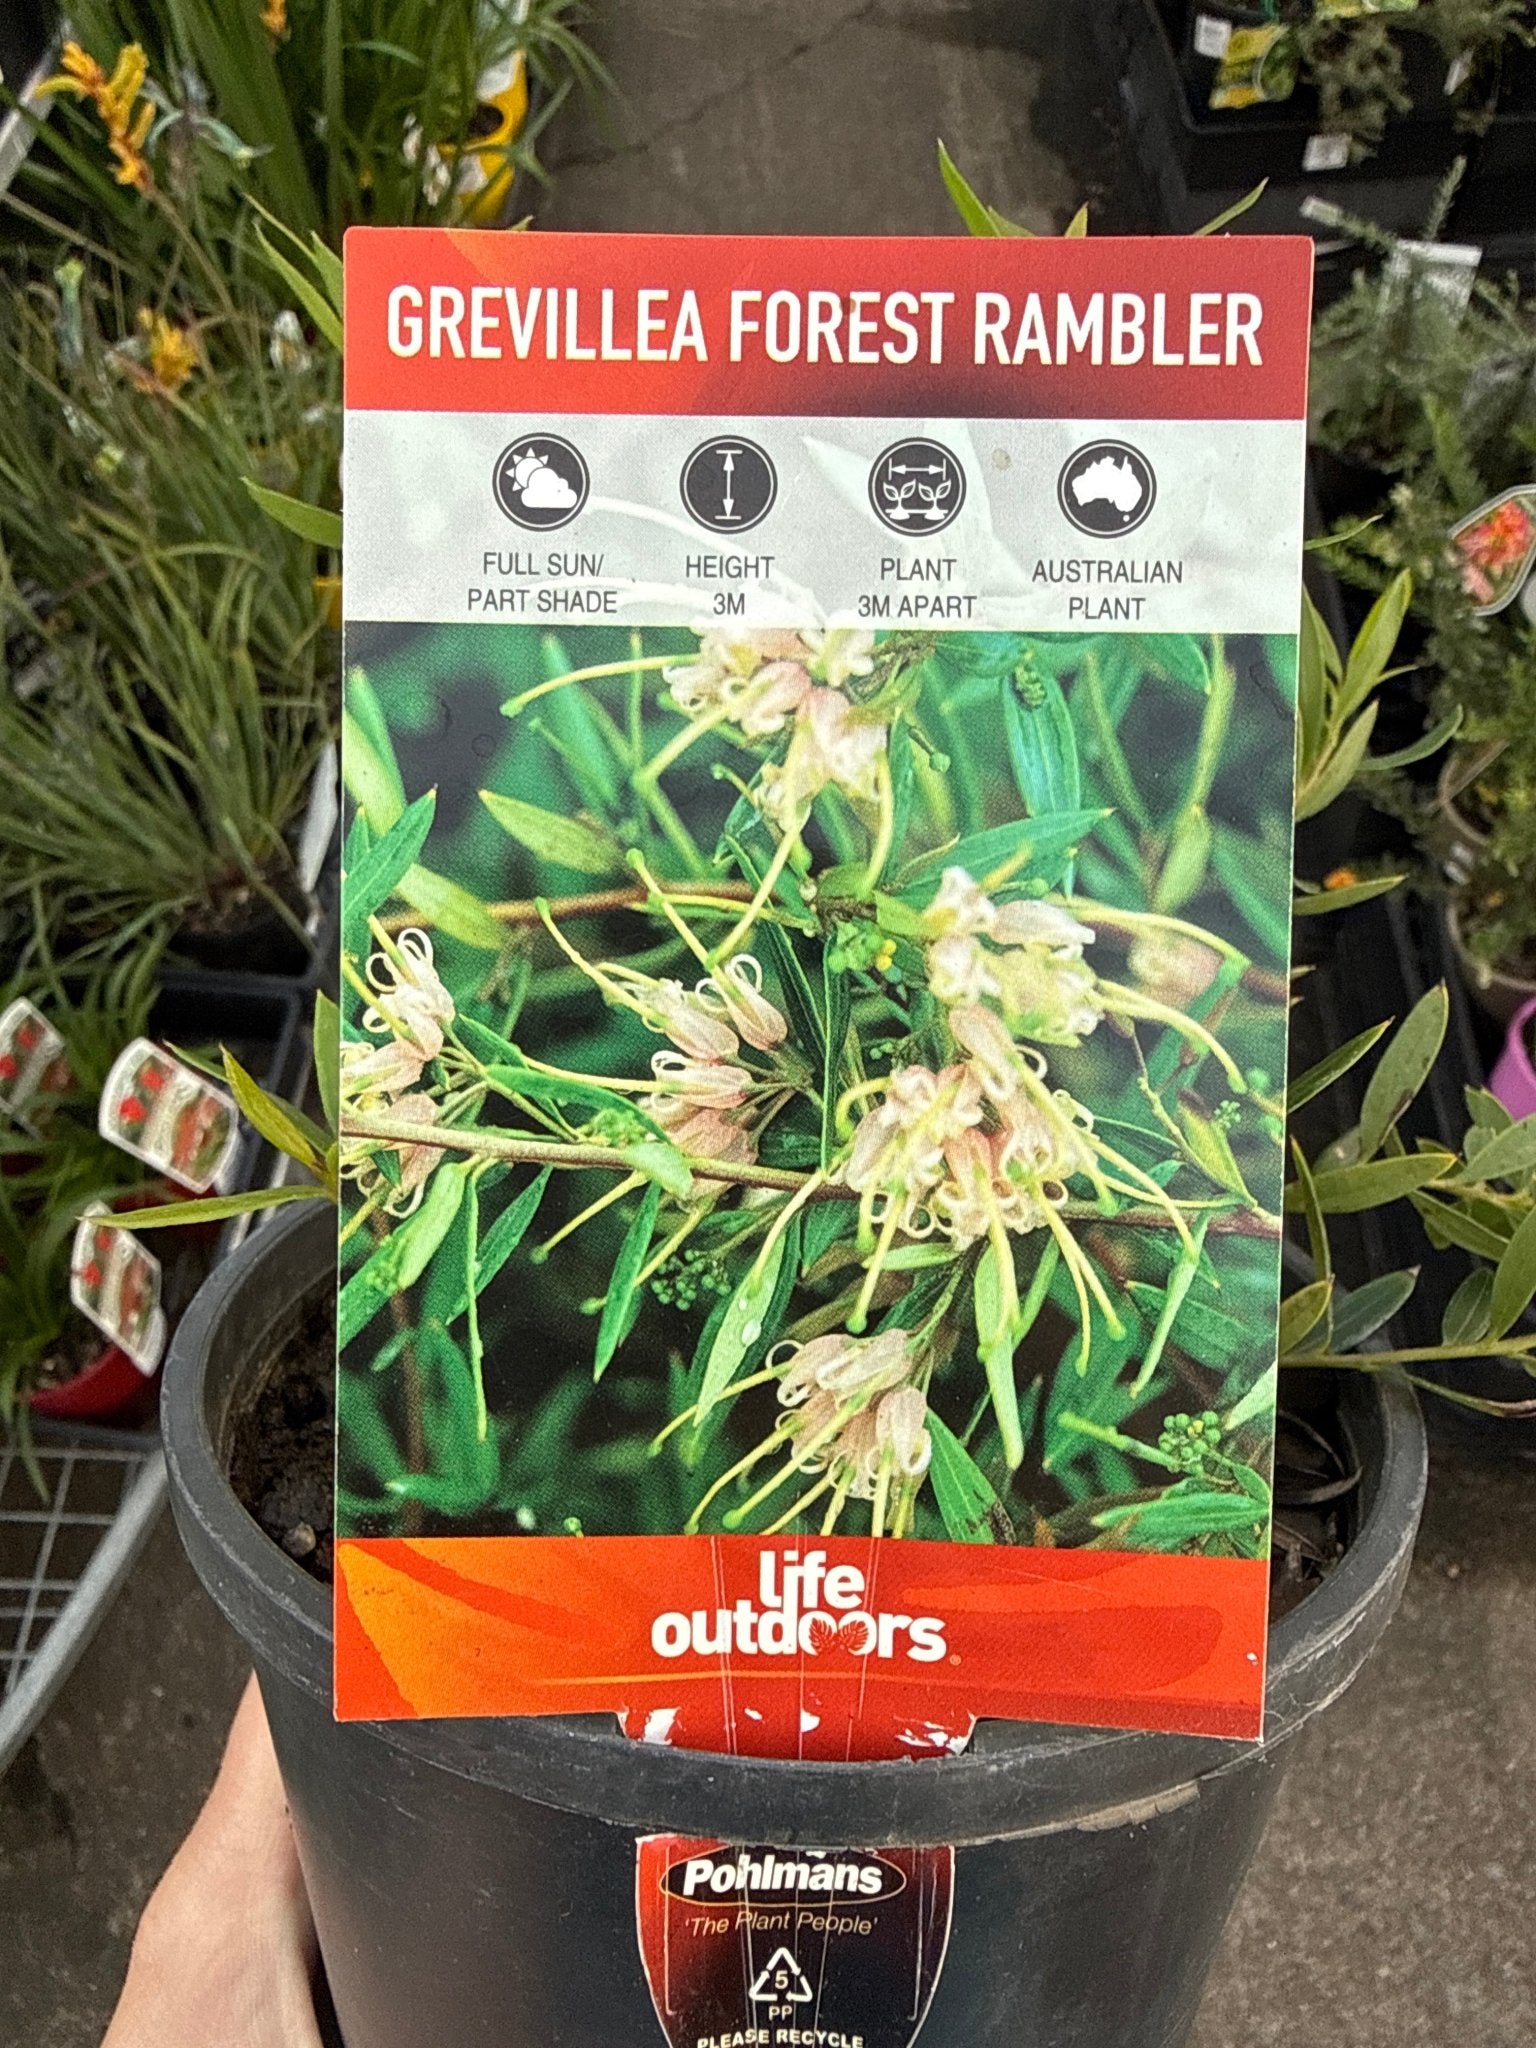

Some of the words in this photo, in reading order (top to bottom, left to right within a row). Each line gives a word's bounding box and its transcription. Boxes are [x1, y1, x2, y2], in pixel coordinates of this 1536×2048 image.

[386, 284, 708, 361] GREVILLEA
[730, 289, 955, 365] FOREST
[974, 291, 1265, 367] RAMBLER
[482, 552, 540, 577] FULL
[546, 554, 604, 579] SUN/
[686, 556, 774, 580] HEIGHT
[880, 558, 956, 582] PLANT
[1032, 560, 1183, 584] AUSTRALIAN
[468, 589, 527, 613] PART
[535, 590, 618, 614] SHADE
[713, 593, 746, 616] 3M
[857, 595, 890, 619] 3M
[895, 596, 977, 620] APART
[1068, 597, 1145, 621] PLANT
[760, 1550, 864, 1609] life
[651, 1600, 946, 1662] outdoors
[683, 1853, 883, 1895] Pohlmans
[736, 1911, 790, 1932] Plant
[774, 1970, 789, 1989] 5
[768, 2005, 793, 2021] PP
[697, 2029, 770, 2048] PLEASE
[775, 2030, 864, 2048] RECYCLE
